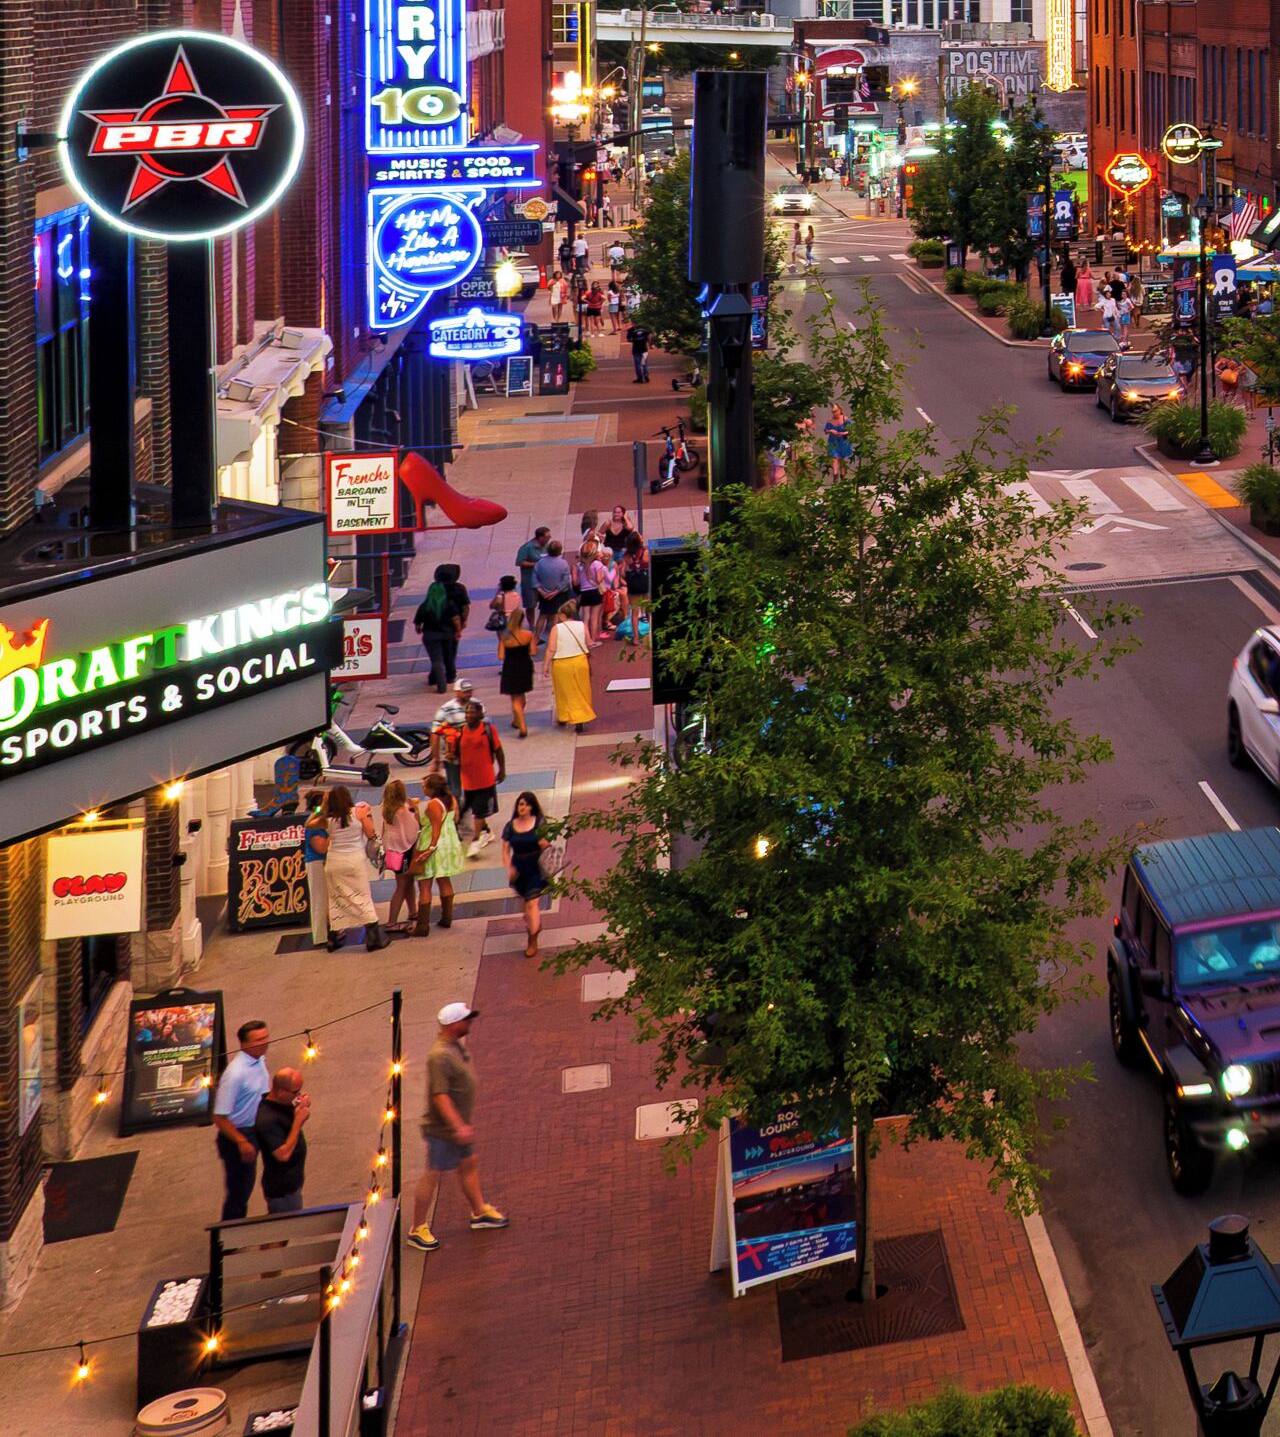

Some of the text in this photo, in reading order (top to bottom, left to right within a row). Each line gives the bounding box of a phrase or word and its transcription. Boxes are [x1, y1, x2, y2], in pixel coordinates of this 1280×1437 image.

[949, 49, 1039, 74] POSITIVE
[371, 85, 462, 126] 10
[102, 121, 254, 150] PBR
[390, 156, 512, 170] MUSIC FOOD
[375, 166, 526, 181] SPIRITS & SPORT
[442, 226, 460, 247] A
[460, 281, 494, 291] OPRY
[431, 326, 520, 342] CATEGORY 10
[338, 486, 388, 497] BARGAINS
[347, 497, 376, 507] IN THE
[336, 517, 388, 528] BASEMENT
[1, 695, 147, 765] SPORTS
[161, 684, 184, 712] &
[196, 642, 317, 701] SOCIAL
[54, 893, 125, 906] PLAYGROUND
